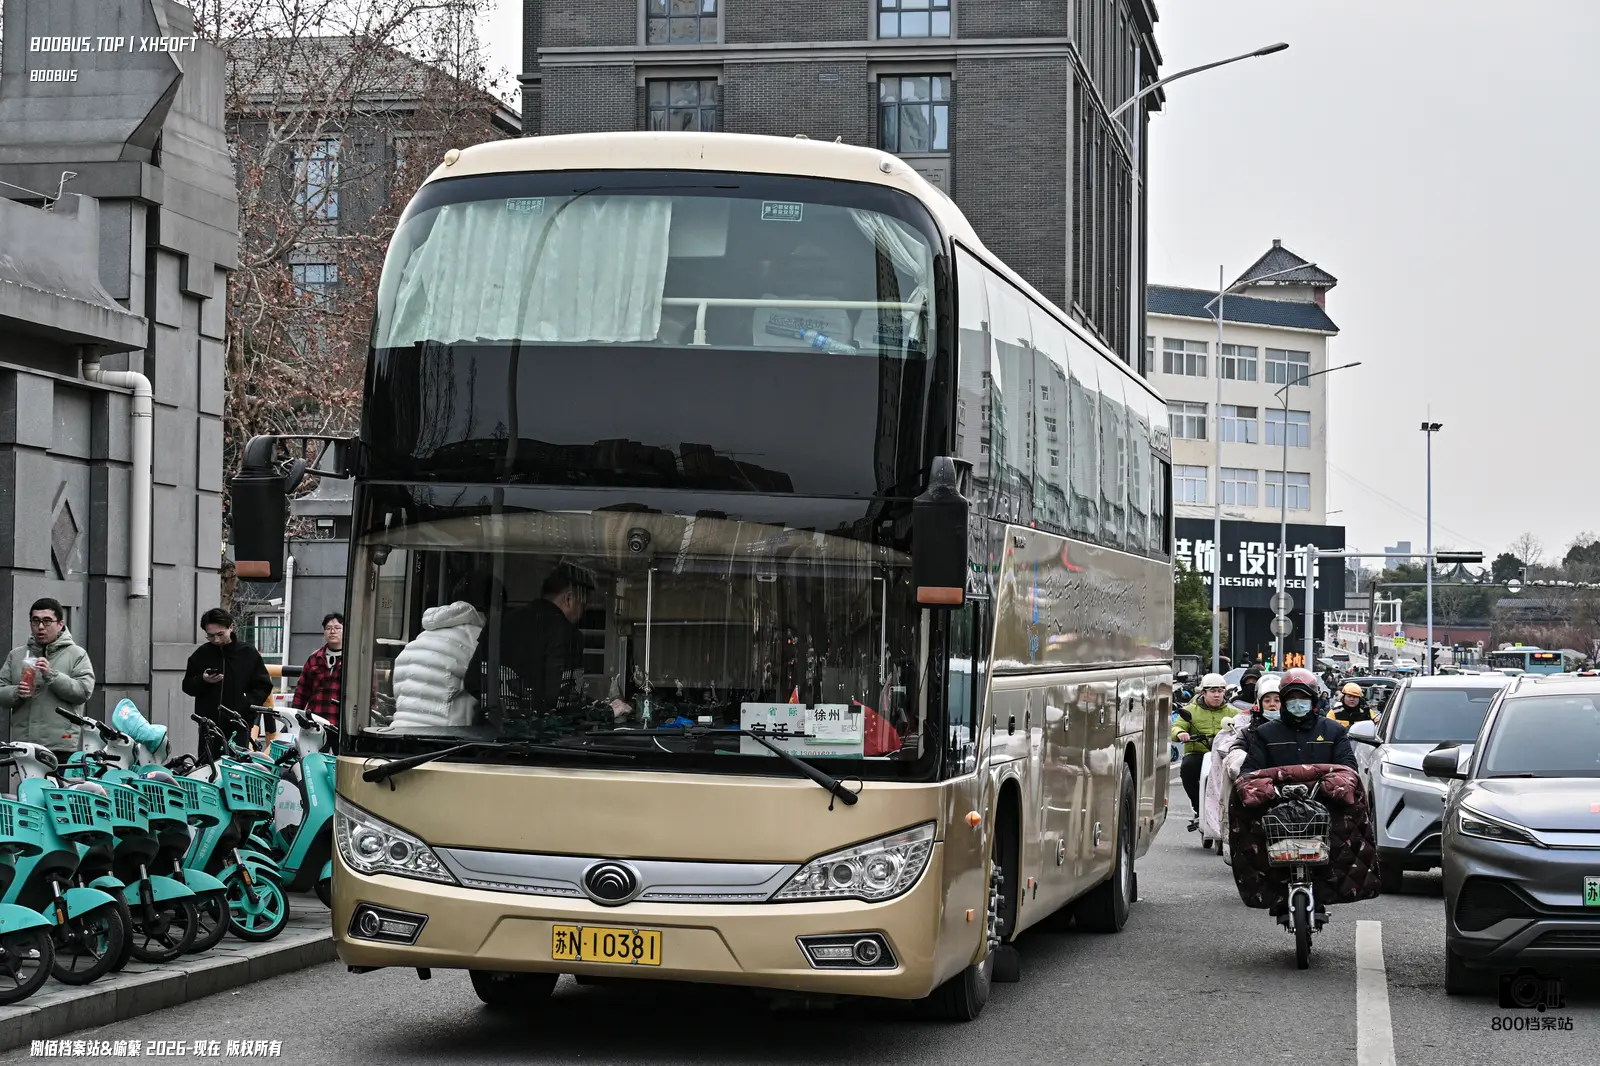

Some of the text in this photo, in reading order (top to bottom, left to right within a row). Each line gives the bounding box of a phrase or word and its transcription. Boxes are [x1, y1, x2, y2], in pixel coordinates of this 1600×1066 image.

[1219, 576, 1262, 588] DESIGN
[1267, 578, 1320, 589] MSEUM
[814, 709, 840, 722] 徐州
